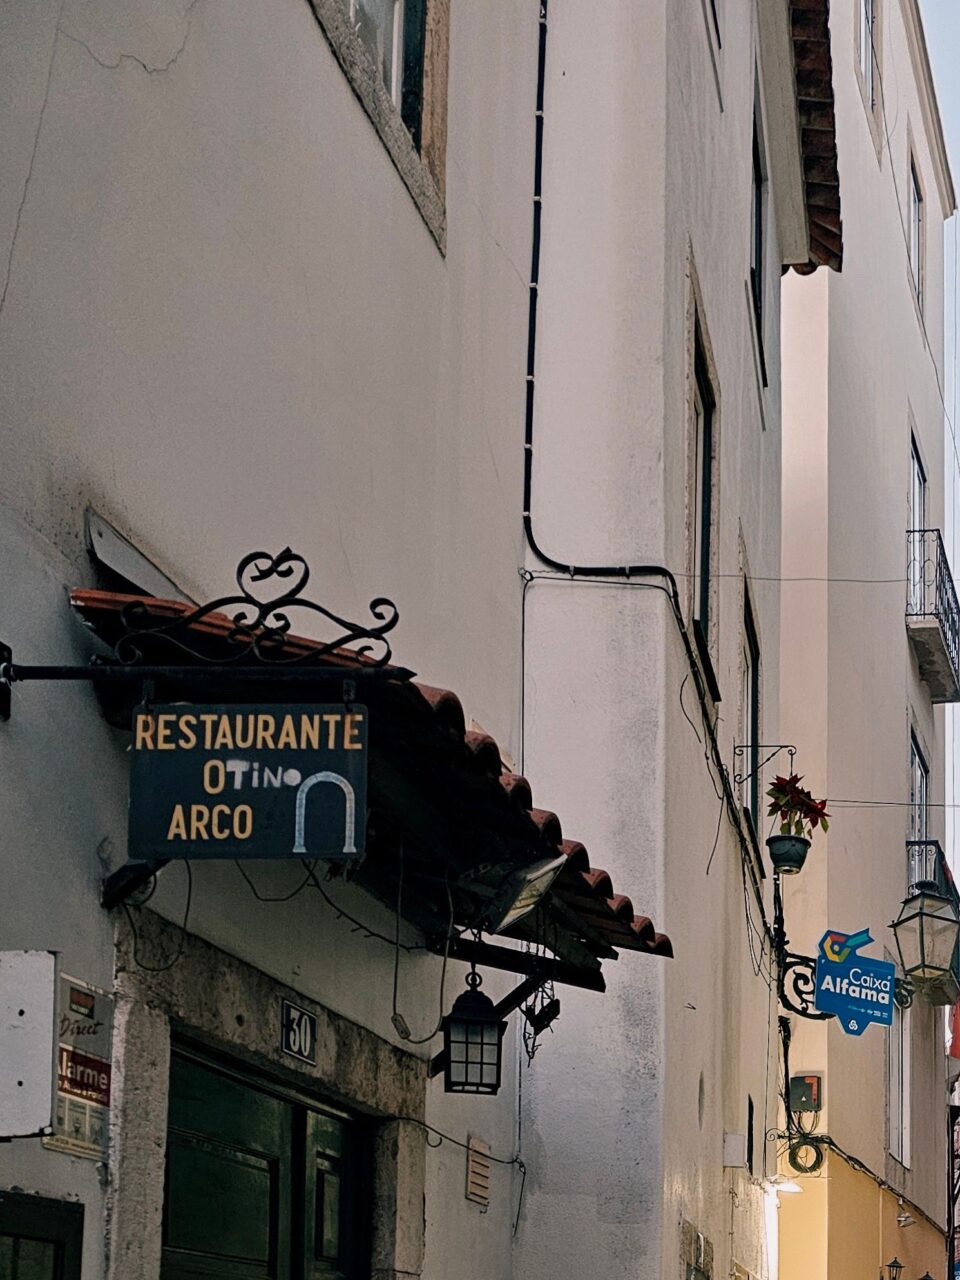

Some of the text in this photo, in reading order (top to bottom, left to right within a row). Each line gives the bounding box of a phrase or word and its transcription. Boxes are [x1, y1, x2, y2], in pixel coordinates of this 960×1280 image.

[135, 714, 363, 750] RESTAURANTE
[167, 804, 253, 840] ARCO
[821, 975, 889, 1004] Alfama
[850, 968, 890, 991] Caixa
[58, 1014, 104, 1037] Direct
[290, 1008, 310, 1056] 30
